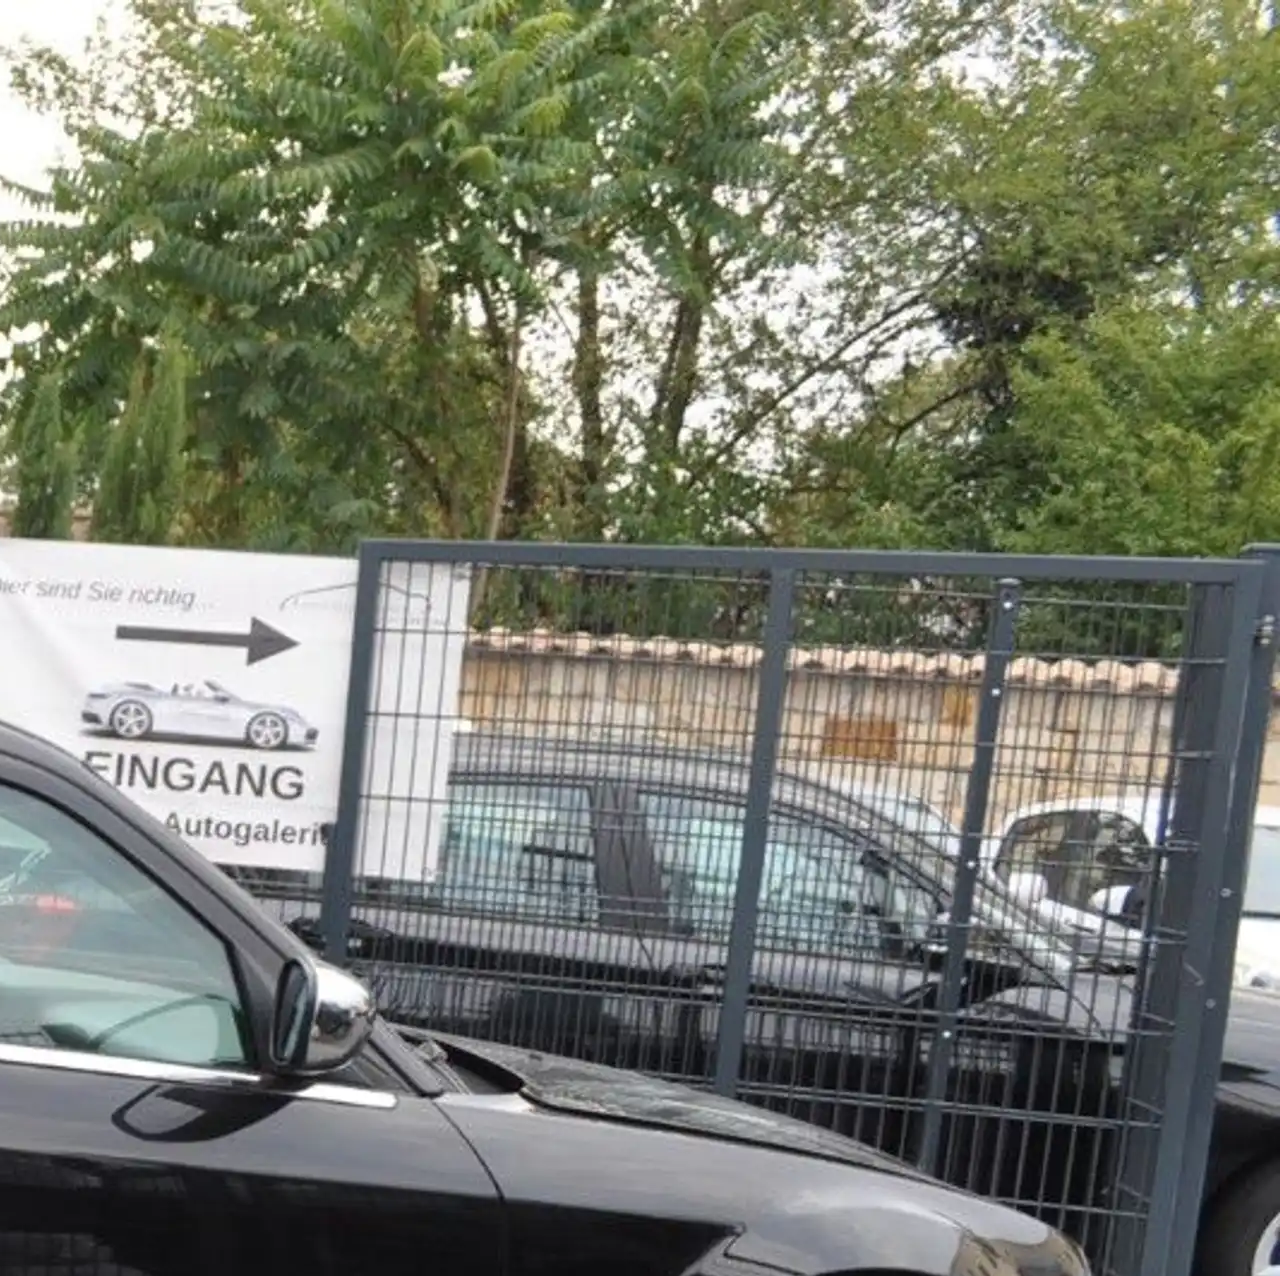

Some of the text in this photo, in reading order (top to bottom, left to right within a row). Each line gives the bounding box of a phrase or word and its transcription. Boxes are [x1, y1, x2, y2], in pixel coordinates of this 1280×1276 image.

[36, 579, 82, 599] sind
[87, 579, 123, 602] Sie
[85, 751, 305, 800] EINGANG
